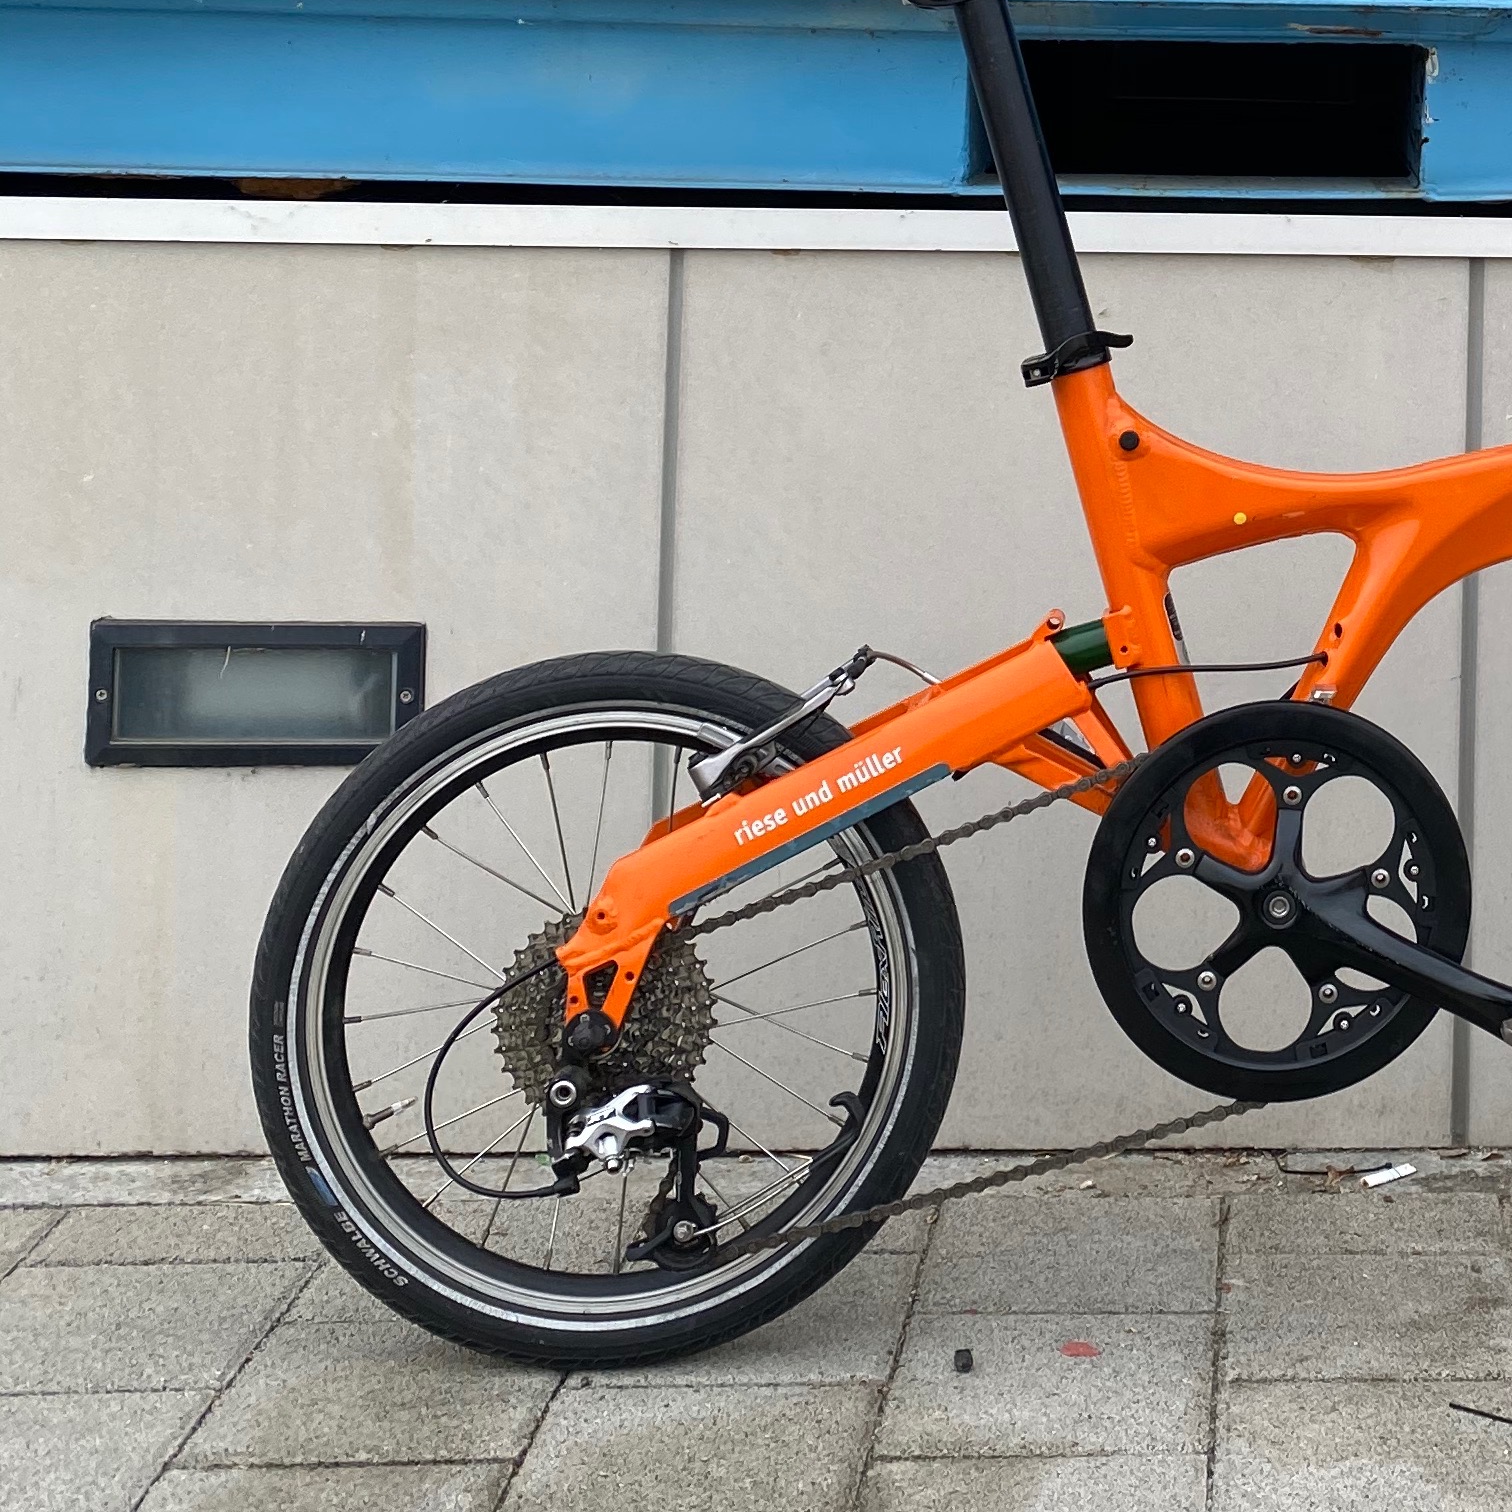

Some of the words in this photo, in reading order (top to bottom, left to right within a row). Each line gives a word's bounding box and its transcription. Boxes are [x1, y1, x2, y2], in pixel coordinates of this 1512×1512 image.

[733, 807, 789, 846] riese
[791, 779, 834, 817] und
[836, 746, 902, 793] müller
[272, 1034, 288, 1083] RACER
[278, 1086, 313, 1162] MARATHON
[332, 1210, 409, 1287] SCHWALBE
